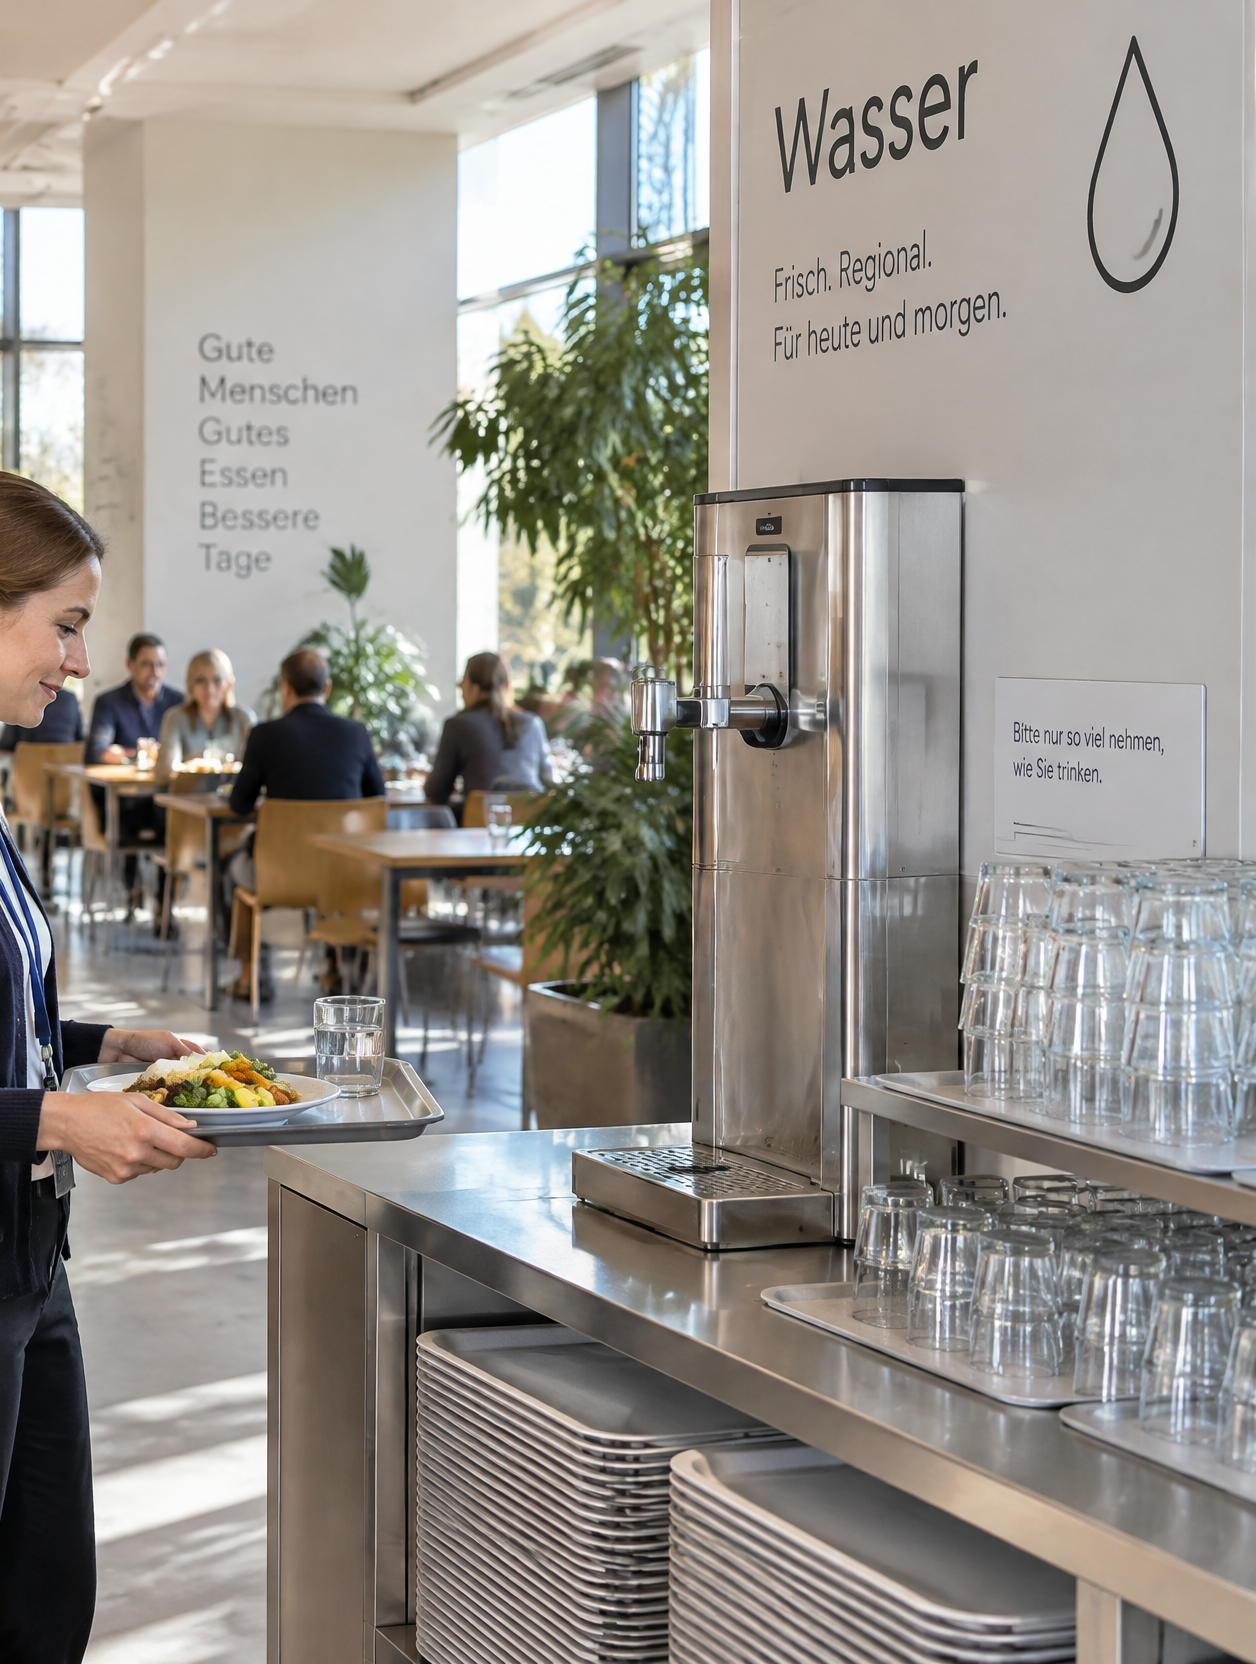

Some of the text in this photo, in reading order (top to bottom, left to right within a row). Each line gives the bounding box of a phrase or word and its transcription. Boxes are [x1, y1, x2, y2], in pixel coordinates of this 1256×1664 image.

[774, 59, 979, 194] Wasser
[774, 229, 932, 303] Frisch. Regional.
[774, 290, 1007, 362] Für heute und morgen.
[198, 333, 275, 364] Gute
[199, 374, 359, 406] Menschen
[198, 416, 290, 447] Gutes
[199, 458, 288, 489] Essen
[199, 501, 321, 532] Bessere
[199, 543, 273, 580] Tage
[1013, 721, 1165, 756] Bitte nur so viel nehmen,
[1012, 757, 1103, 784] wie Sie trinken.
